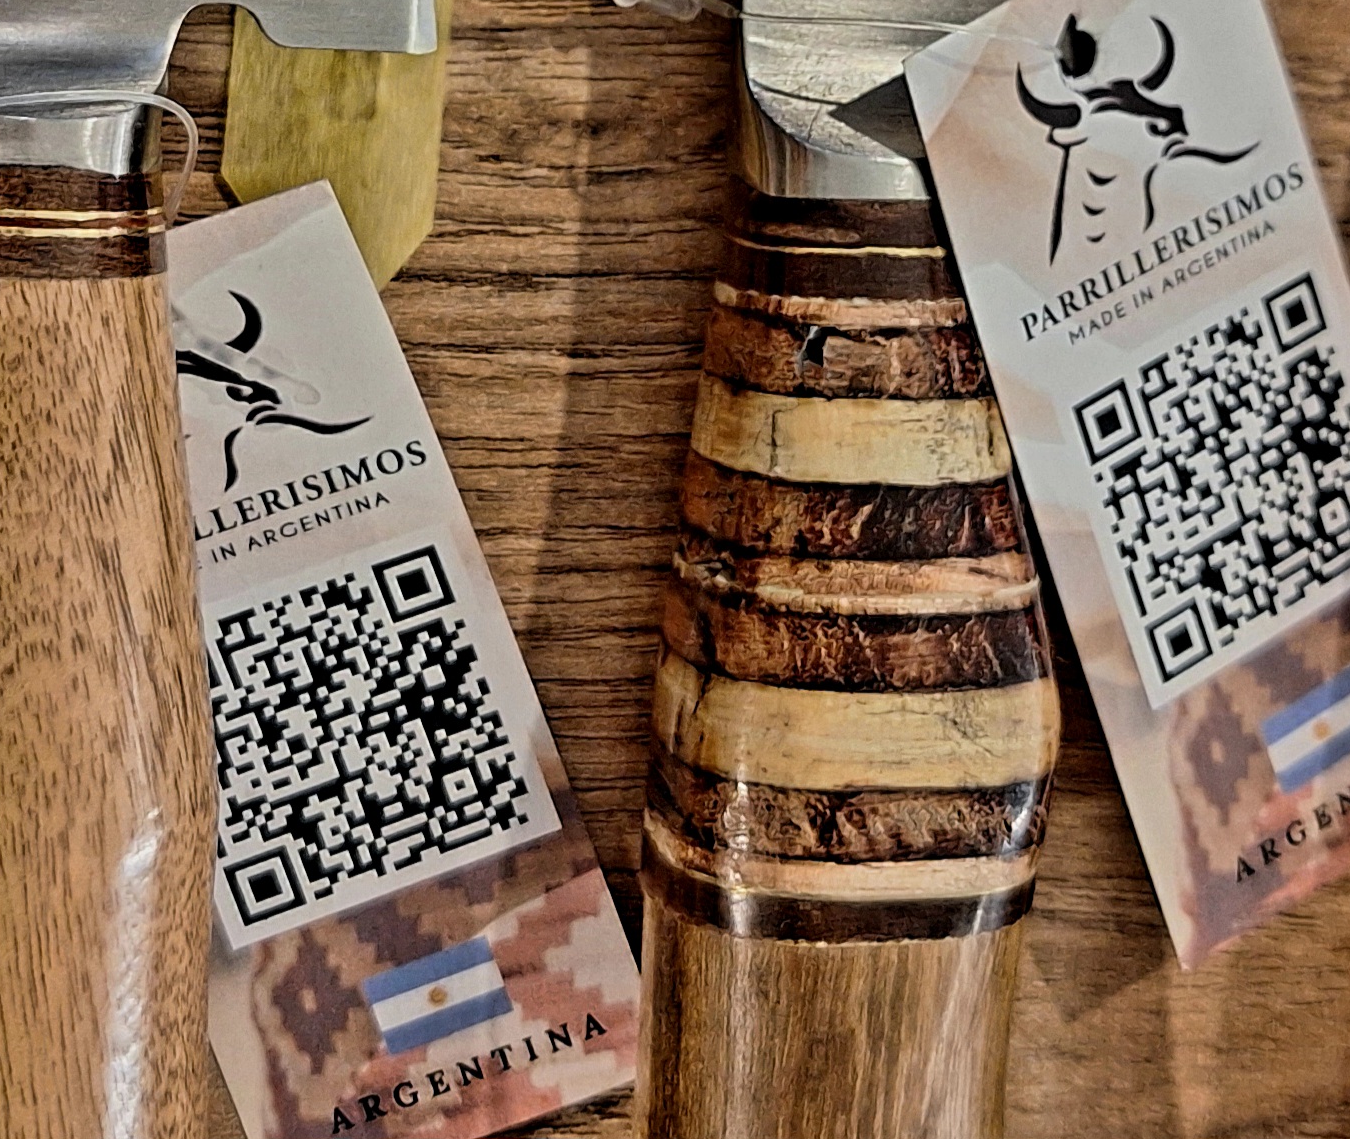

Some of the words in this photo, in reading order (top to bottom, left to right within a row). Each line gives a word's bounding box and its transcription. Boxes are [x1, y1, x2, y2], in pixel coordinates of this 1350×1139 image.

[1019, 162, 1305, 342] PARRILLERISIMOS
[1067, 303, 1128, 345] MADE
[1132, 287, 1155, 311] IN
[1161, 219, 1276, 293] ARGENTINA
[211, 542, 237, 563] IN
[247, 491, 390, 551] ARGENTINA
[331, 1012, 607, 1134] ARGENTINA
